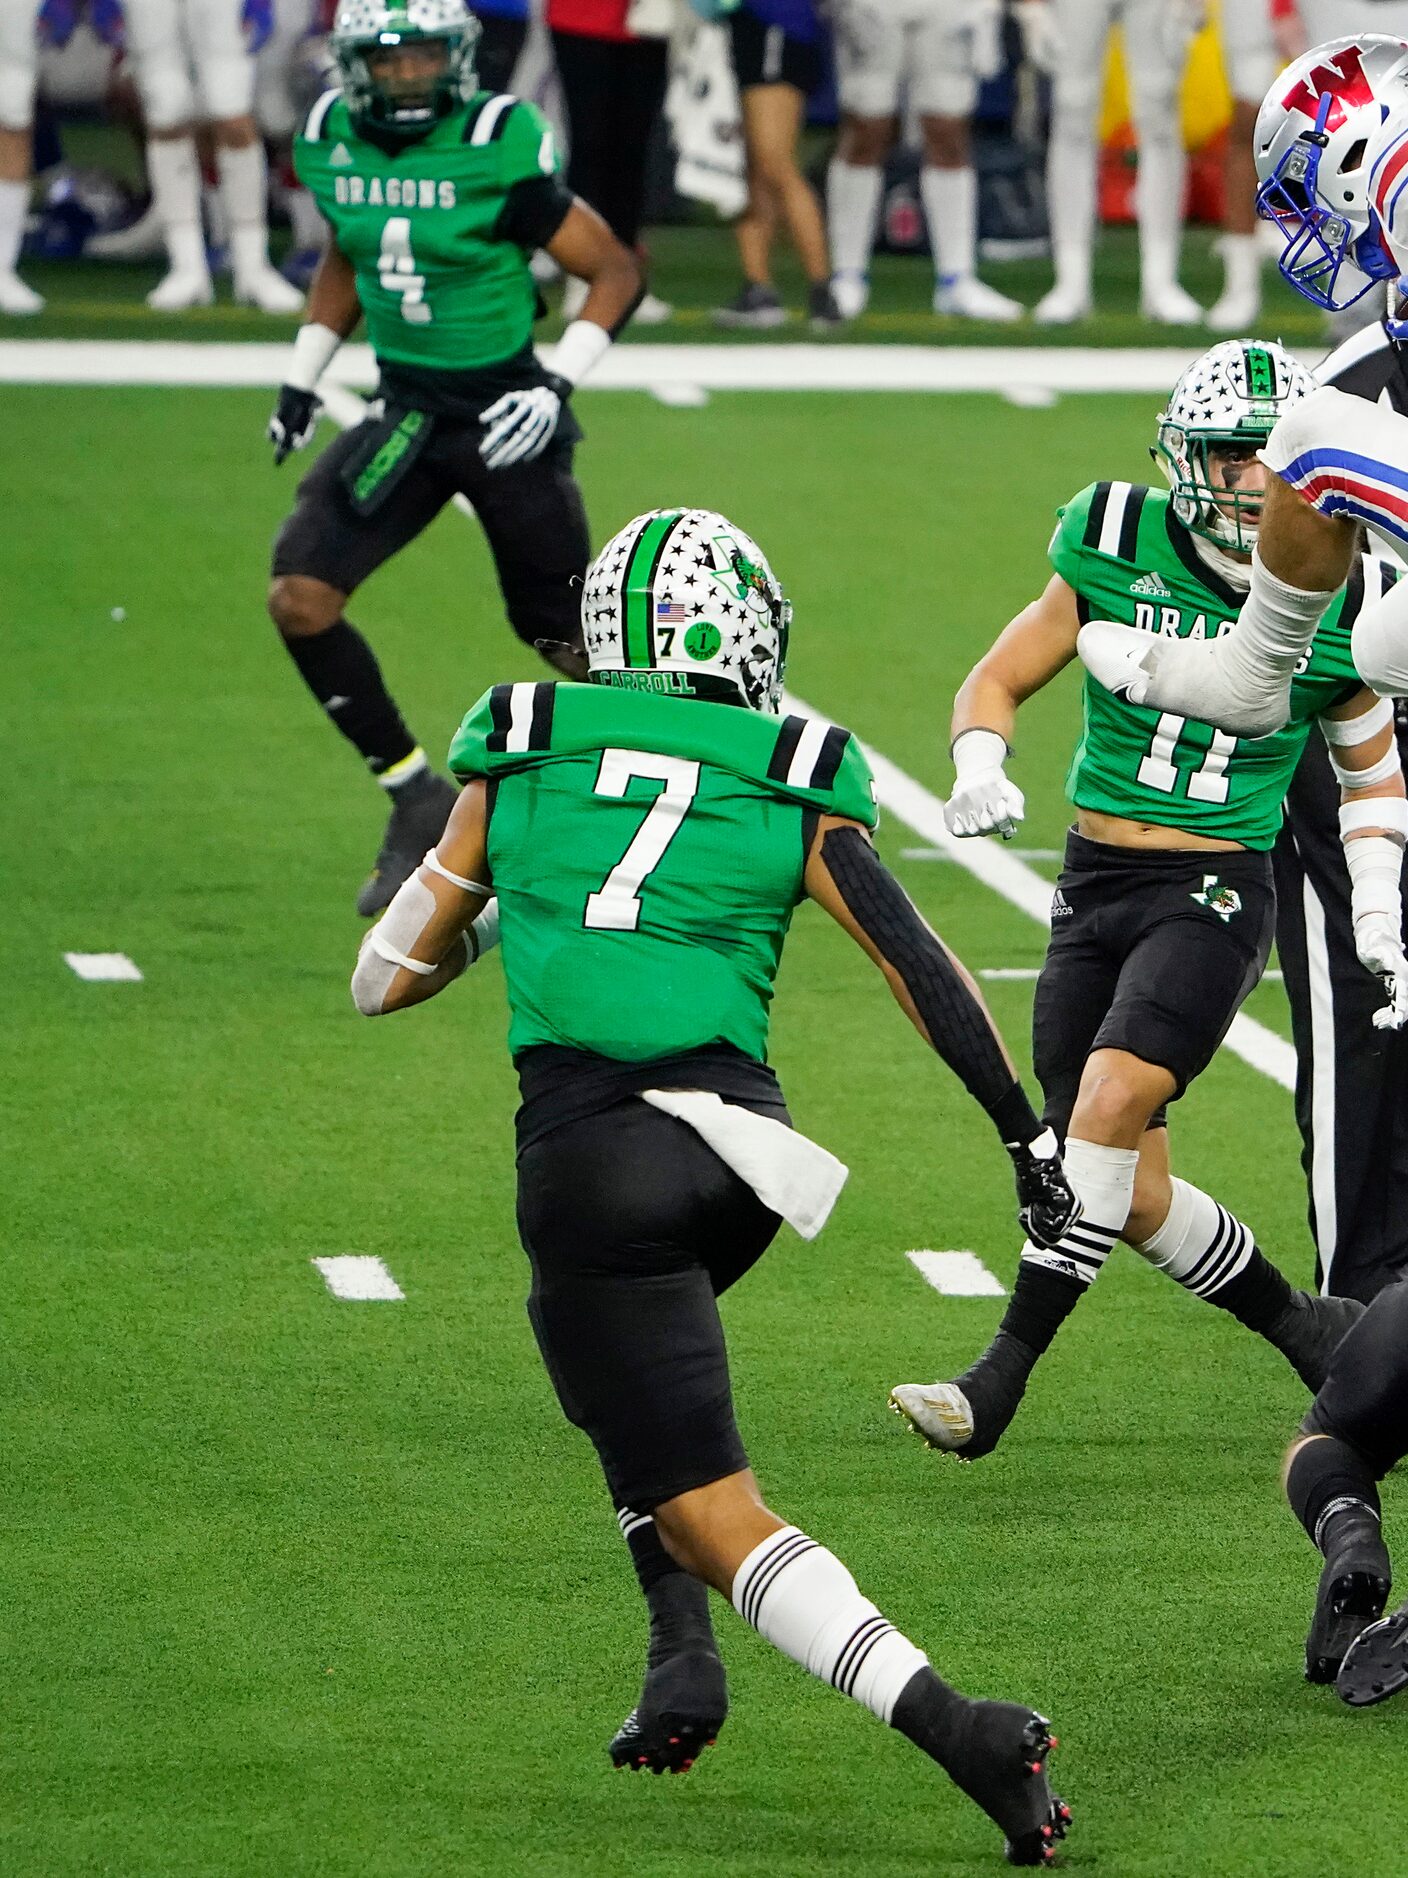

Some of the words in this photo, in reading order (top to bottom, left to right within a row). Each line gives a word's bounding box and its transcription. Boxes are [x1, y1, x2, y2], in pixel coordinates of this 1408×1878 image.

[1281, 45, 1375, 133] W
[335, 175, 456, 210] DRAGONS
[377, 216, 432, 325] 4
[1129, 582, 1171, 598] adidas
[657, 627, 677, 657] 7
[599, 671, 697, 695] CARROLL
[1137, 711, 1238, 806] 11
[582, 747, 703, 932] 7
